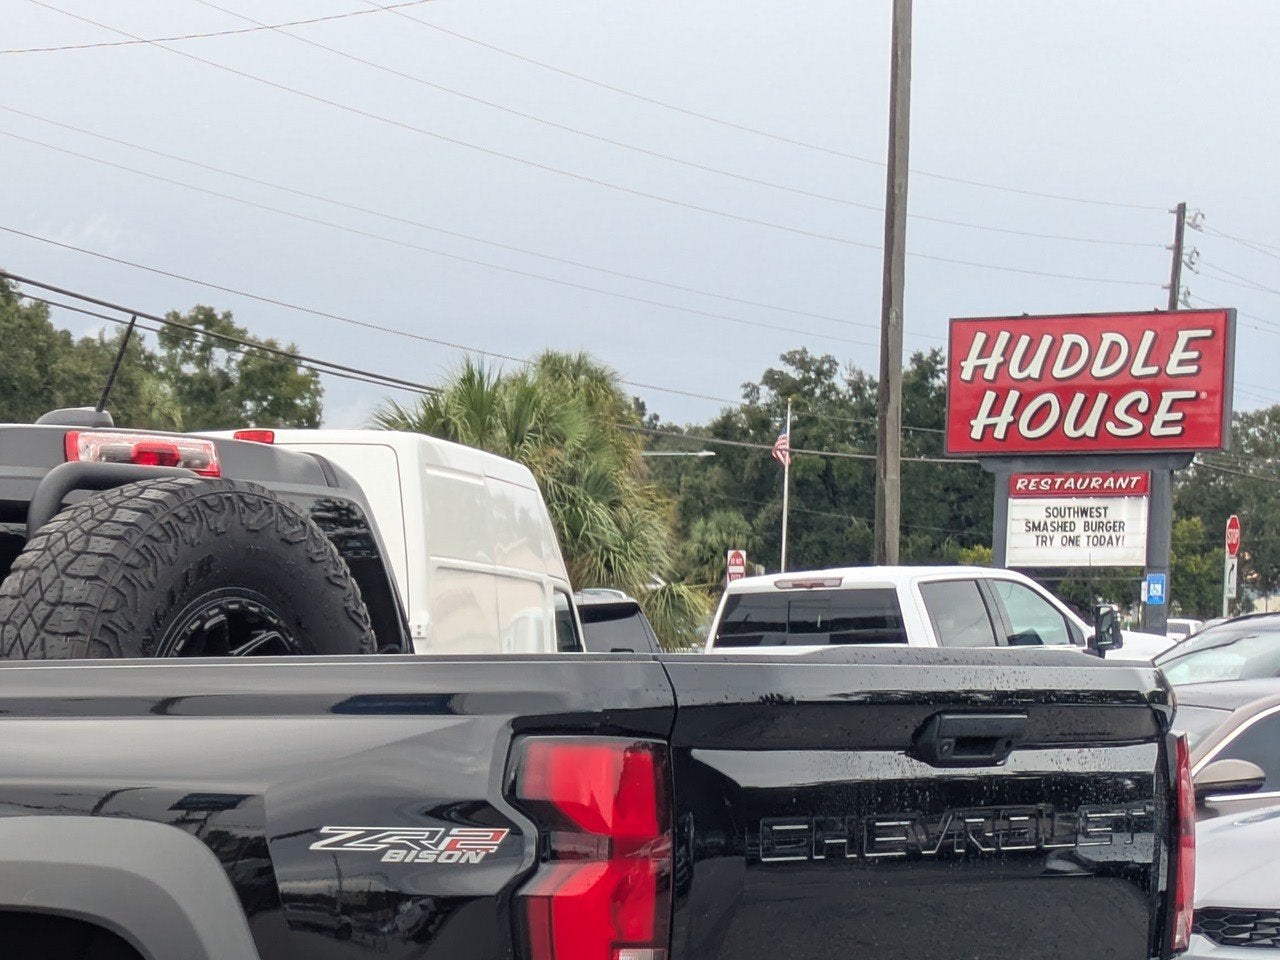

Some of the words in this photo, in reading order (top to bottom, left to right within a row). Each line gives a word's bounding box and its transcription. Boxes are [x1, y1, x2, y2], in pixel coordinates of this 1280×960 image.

[960, 329, 1214, 382] HUDDLE
[970, 389, 1197, 440] HOUSE
[1015, 476, 1141, 491] RESTAURANT
[1045, 506, 1109, 519] SOUTHWEST
[1024, 520, 1076, 533] SMASHED
[1083, 520, 1126, 533] BURGER
[1034, 535, 1055, 547] TRY
[1060, 535, 1081, 547] ONE
[1086, 535, 1125, 547] TODAY!
[309, 826, 510, 853] ZR2
[760, 804, 1153, 862] CHEVROLET
[381, 850, 486, 864] BISON
